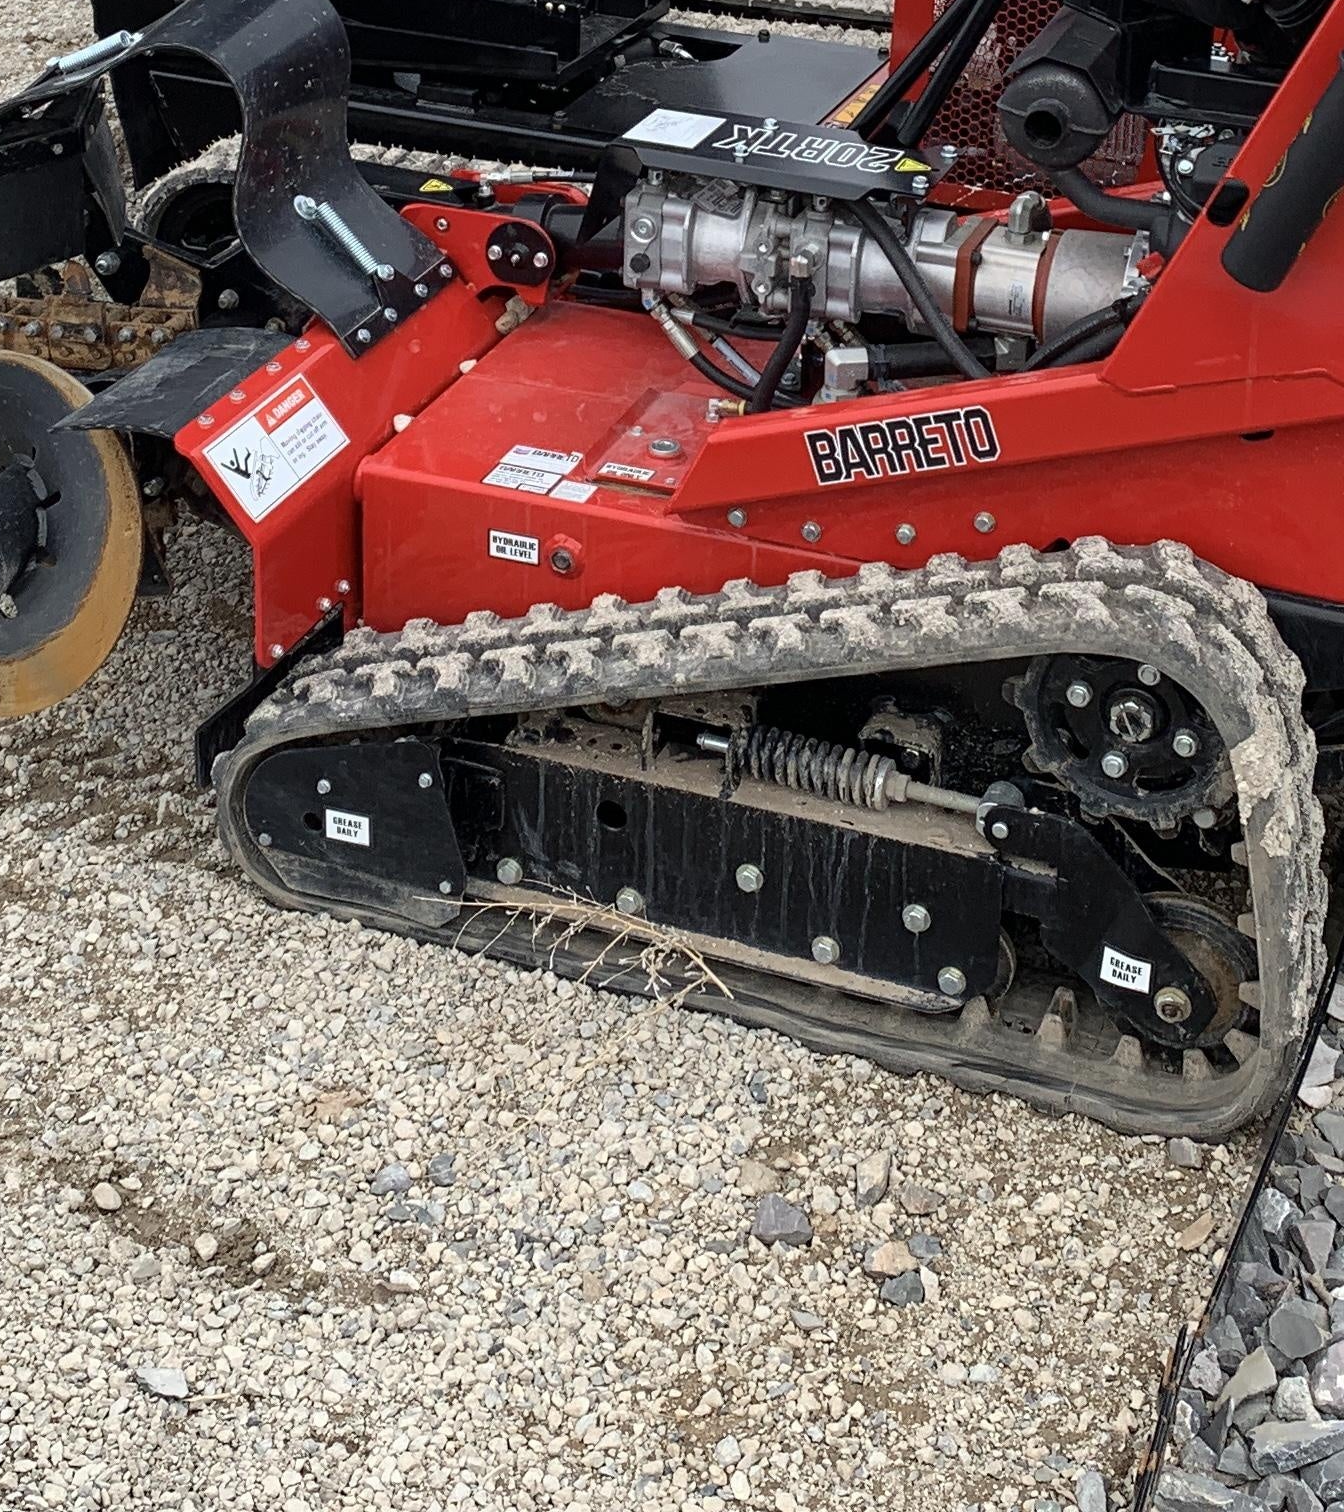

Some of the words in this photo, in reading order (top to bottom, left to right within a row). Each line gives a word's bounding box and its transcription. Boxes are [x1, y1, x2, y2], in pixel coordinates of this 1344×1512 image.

[712, 124, 905, 173] 20RTK
[271, 388, 306, 419] DANGER
[804, 405, 1001, 486] BARRETO
[492, 535, 537, 551] HYDRAULIC
[495, 545, 507, 553] OIL
[510, 547, 533, 560] LEVEL
[333, 817, 362, 829] GREASE
[336, 826, 358, 838] DAILY
[1110, 956, 1143, 976] GREASE
[1112, 968, 1137, 984] DAILY
